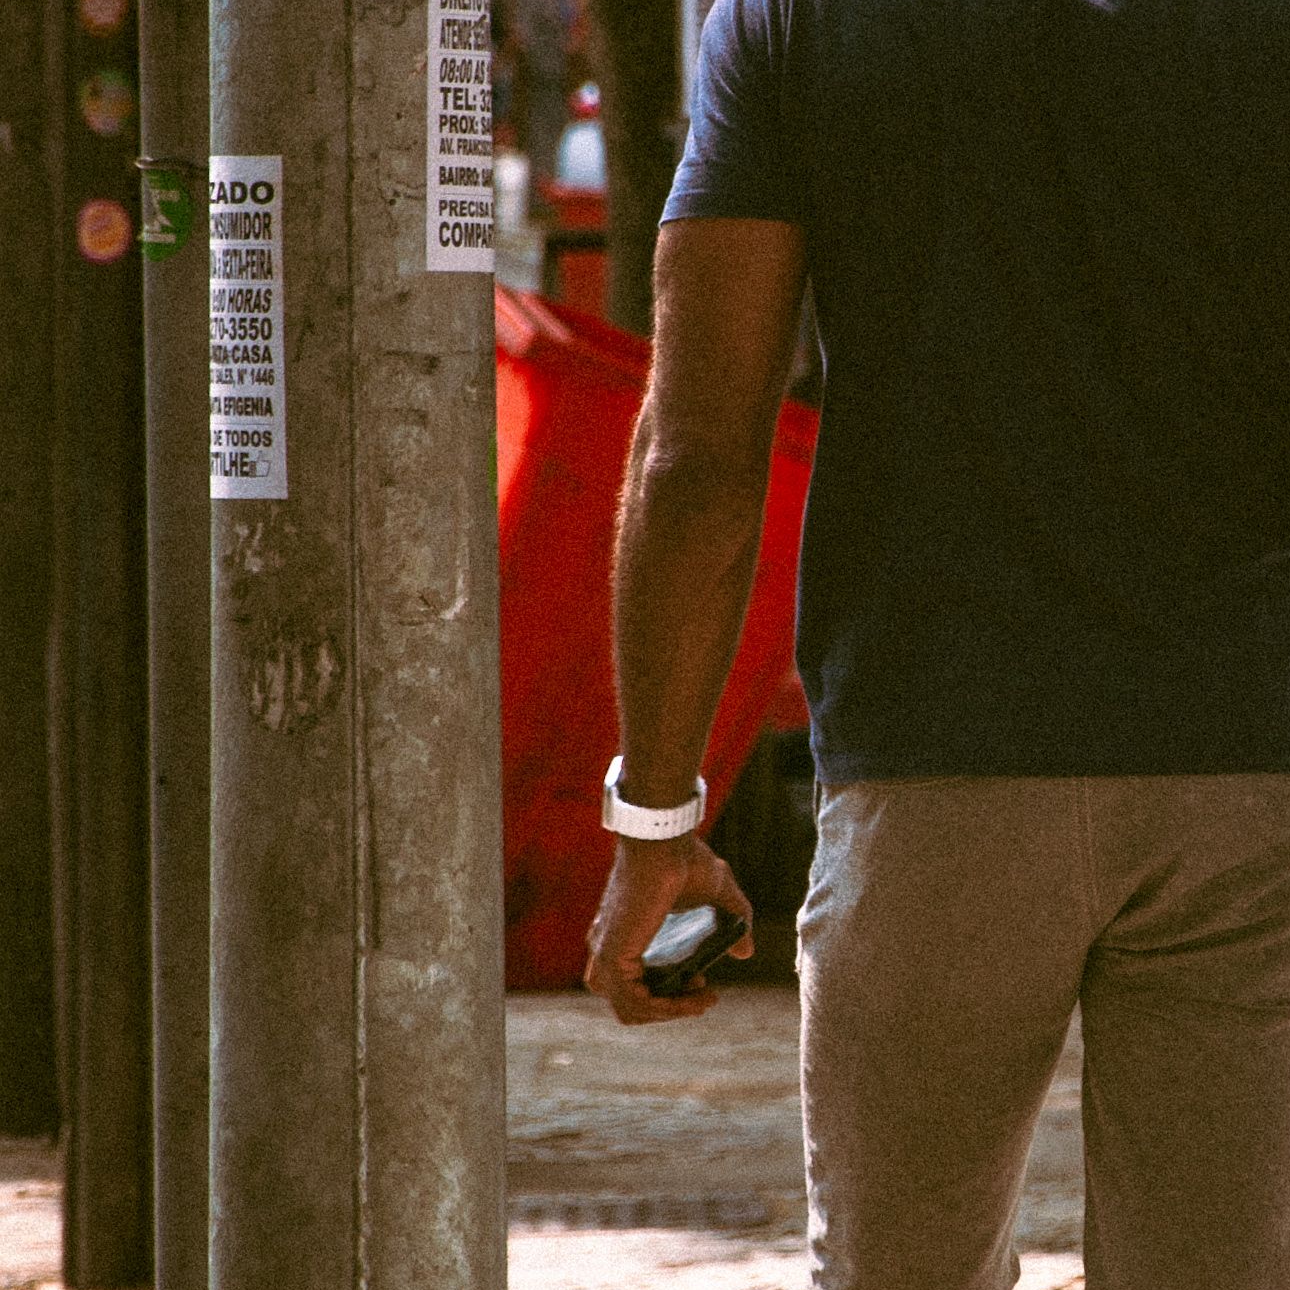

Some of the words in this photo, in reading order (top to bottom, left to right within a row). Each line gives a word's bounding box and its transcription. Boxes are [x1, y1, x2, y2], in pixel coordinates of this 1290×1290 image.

[439, 57, 472, 84] 08:00
[440, 86, 477, 111] TEL:
[439, 114, 478, 135] PROX:
[439, 138, 455, 155] AV.
[439, 165, 479, 187] BAIRRO:
[439, 199, 489, 218] PRECISA
[228, 288, 273, 313] HORAS
[231, 345, 273, 364] CASA
[250, 368, 275, 386] 1446
[223, 396, 274, 417] EFIGENIA
[225, 430, 273, 447] TODOS
